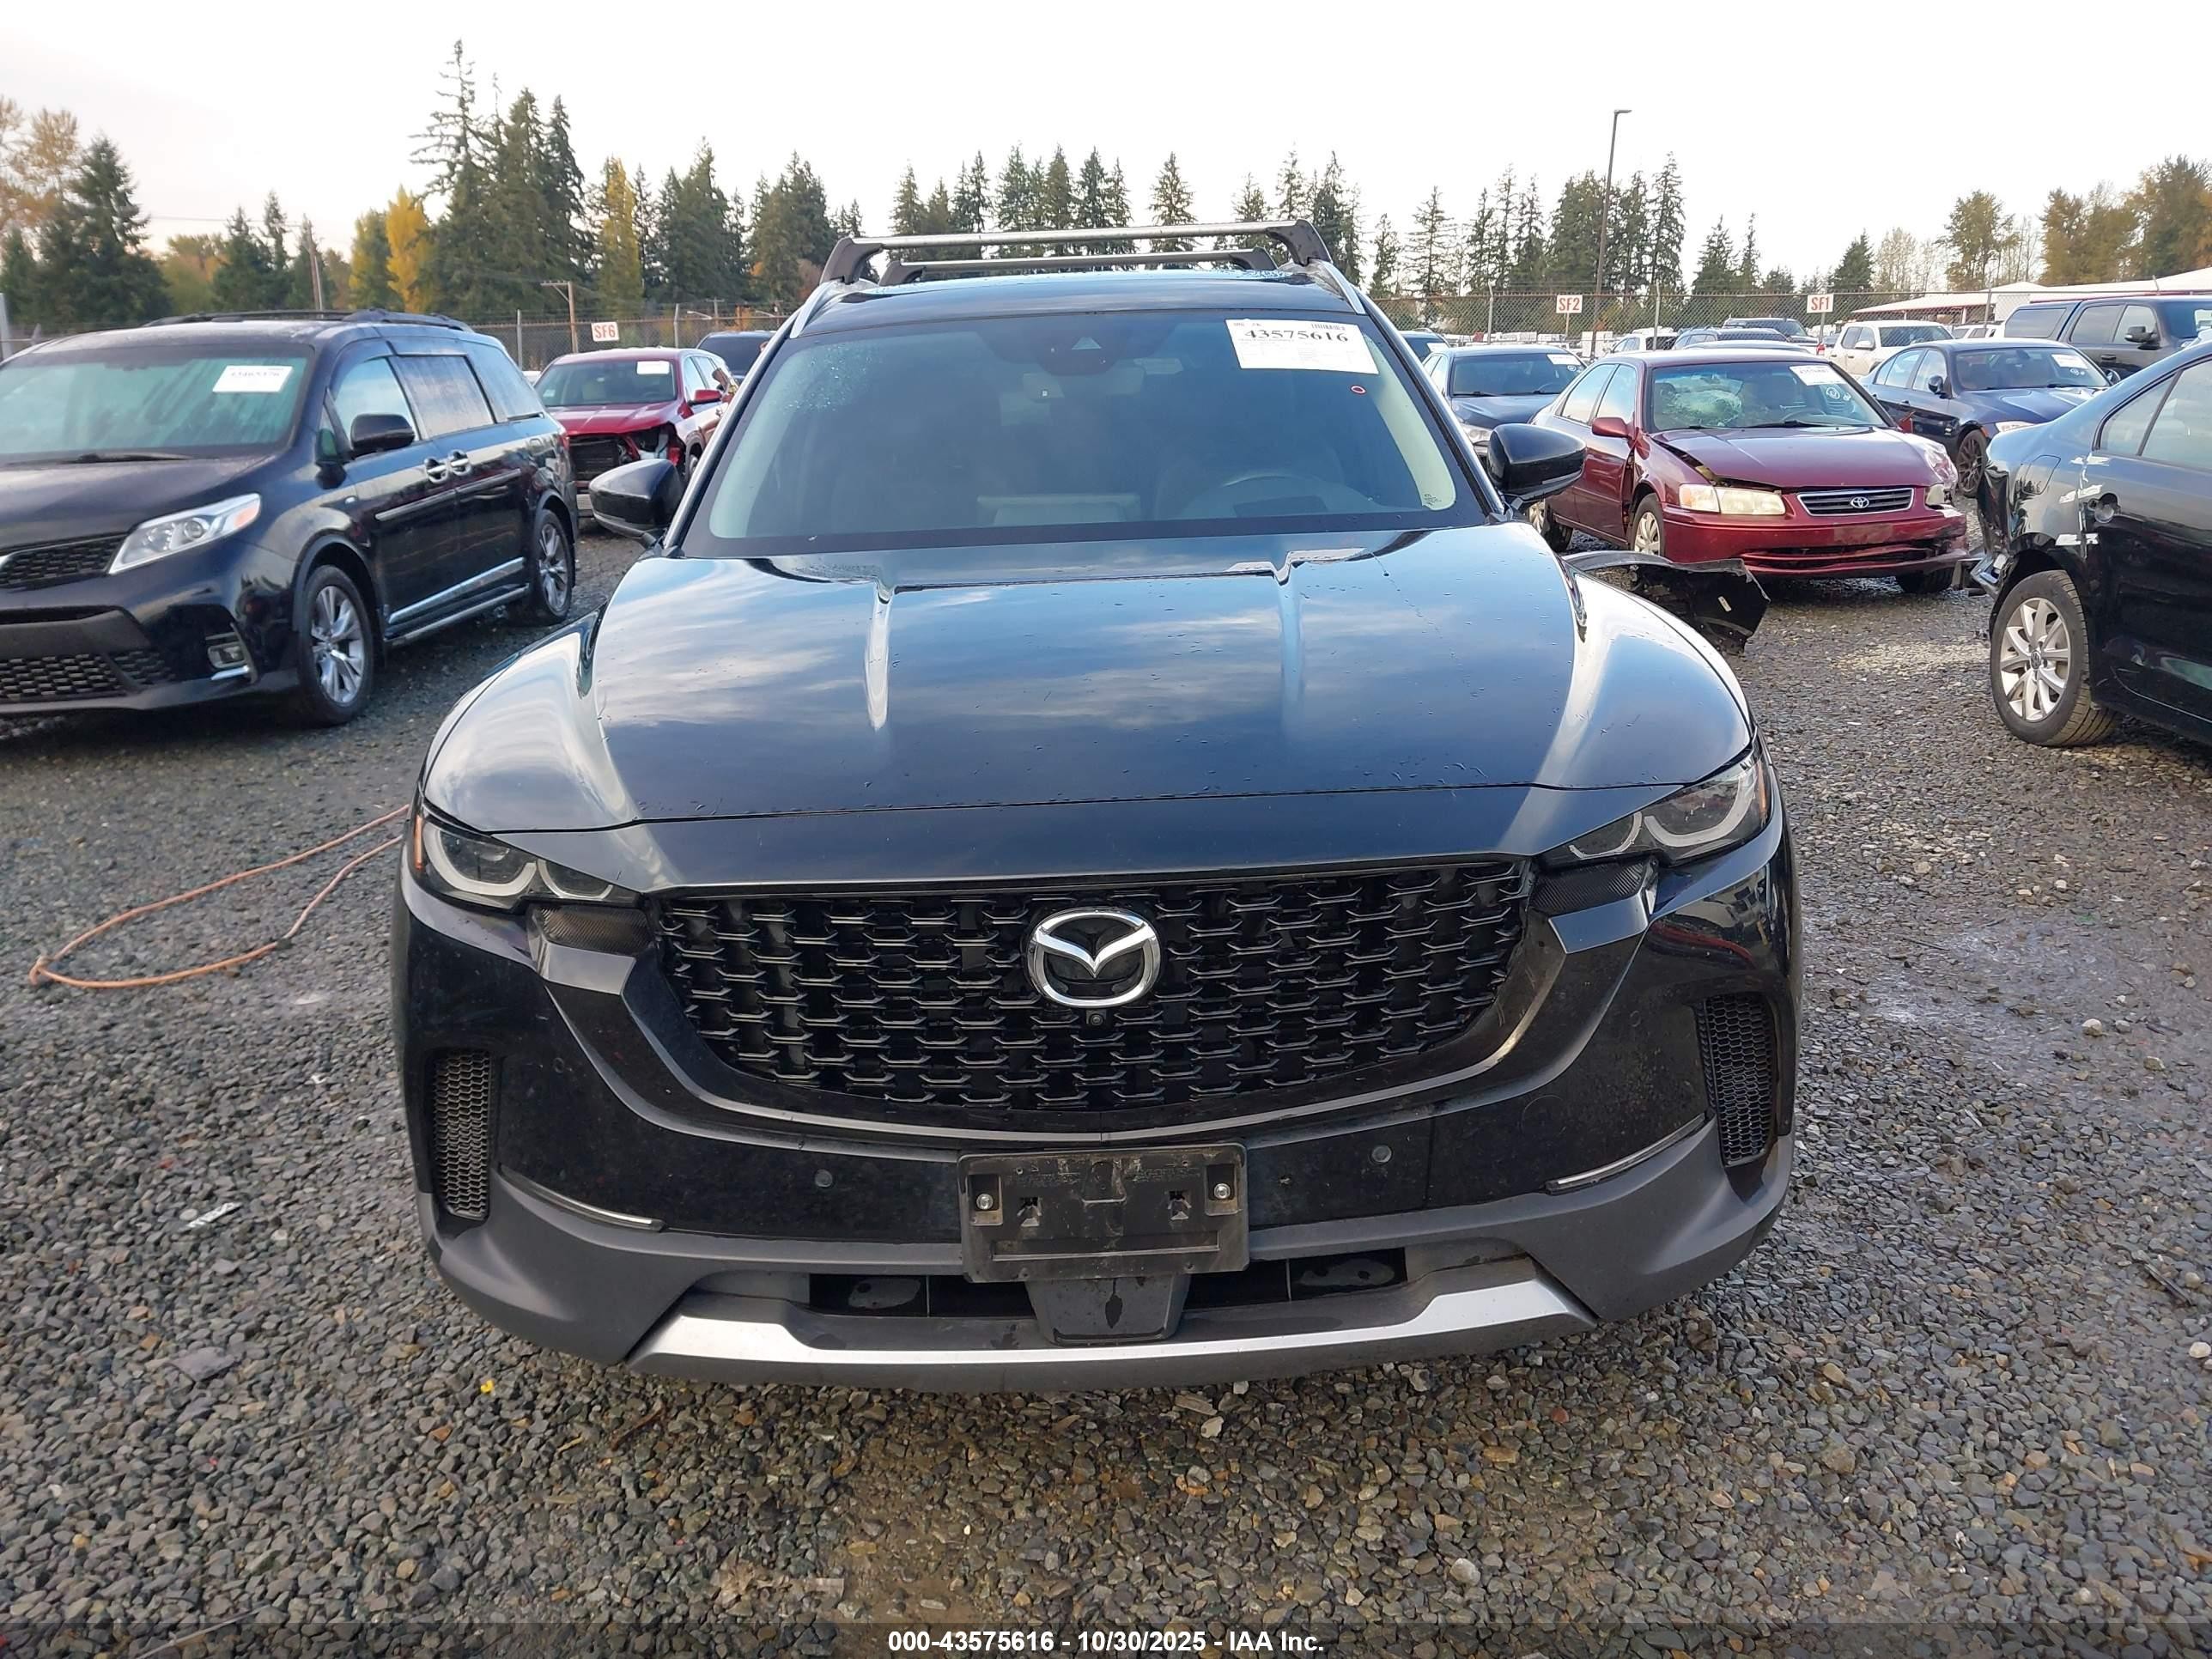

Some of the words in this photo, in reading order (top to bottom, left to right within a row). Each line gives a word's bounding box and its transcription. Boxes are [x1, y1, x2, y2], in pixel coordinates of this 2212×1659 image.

[1559, 297, 1580, 311] SF2
[1811, 296, 1829, 310] SF1
[594, 324, 616, 338] SF6
[1244, 329, 1349, 342] 43575616
